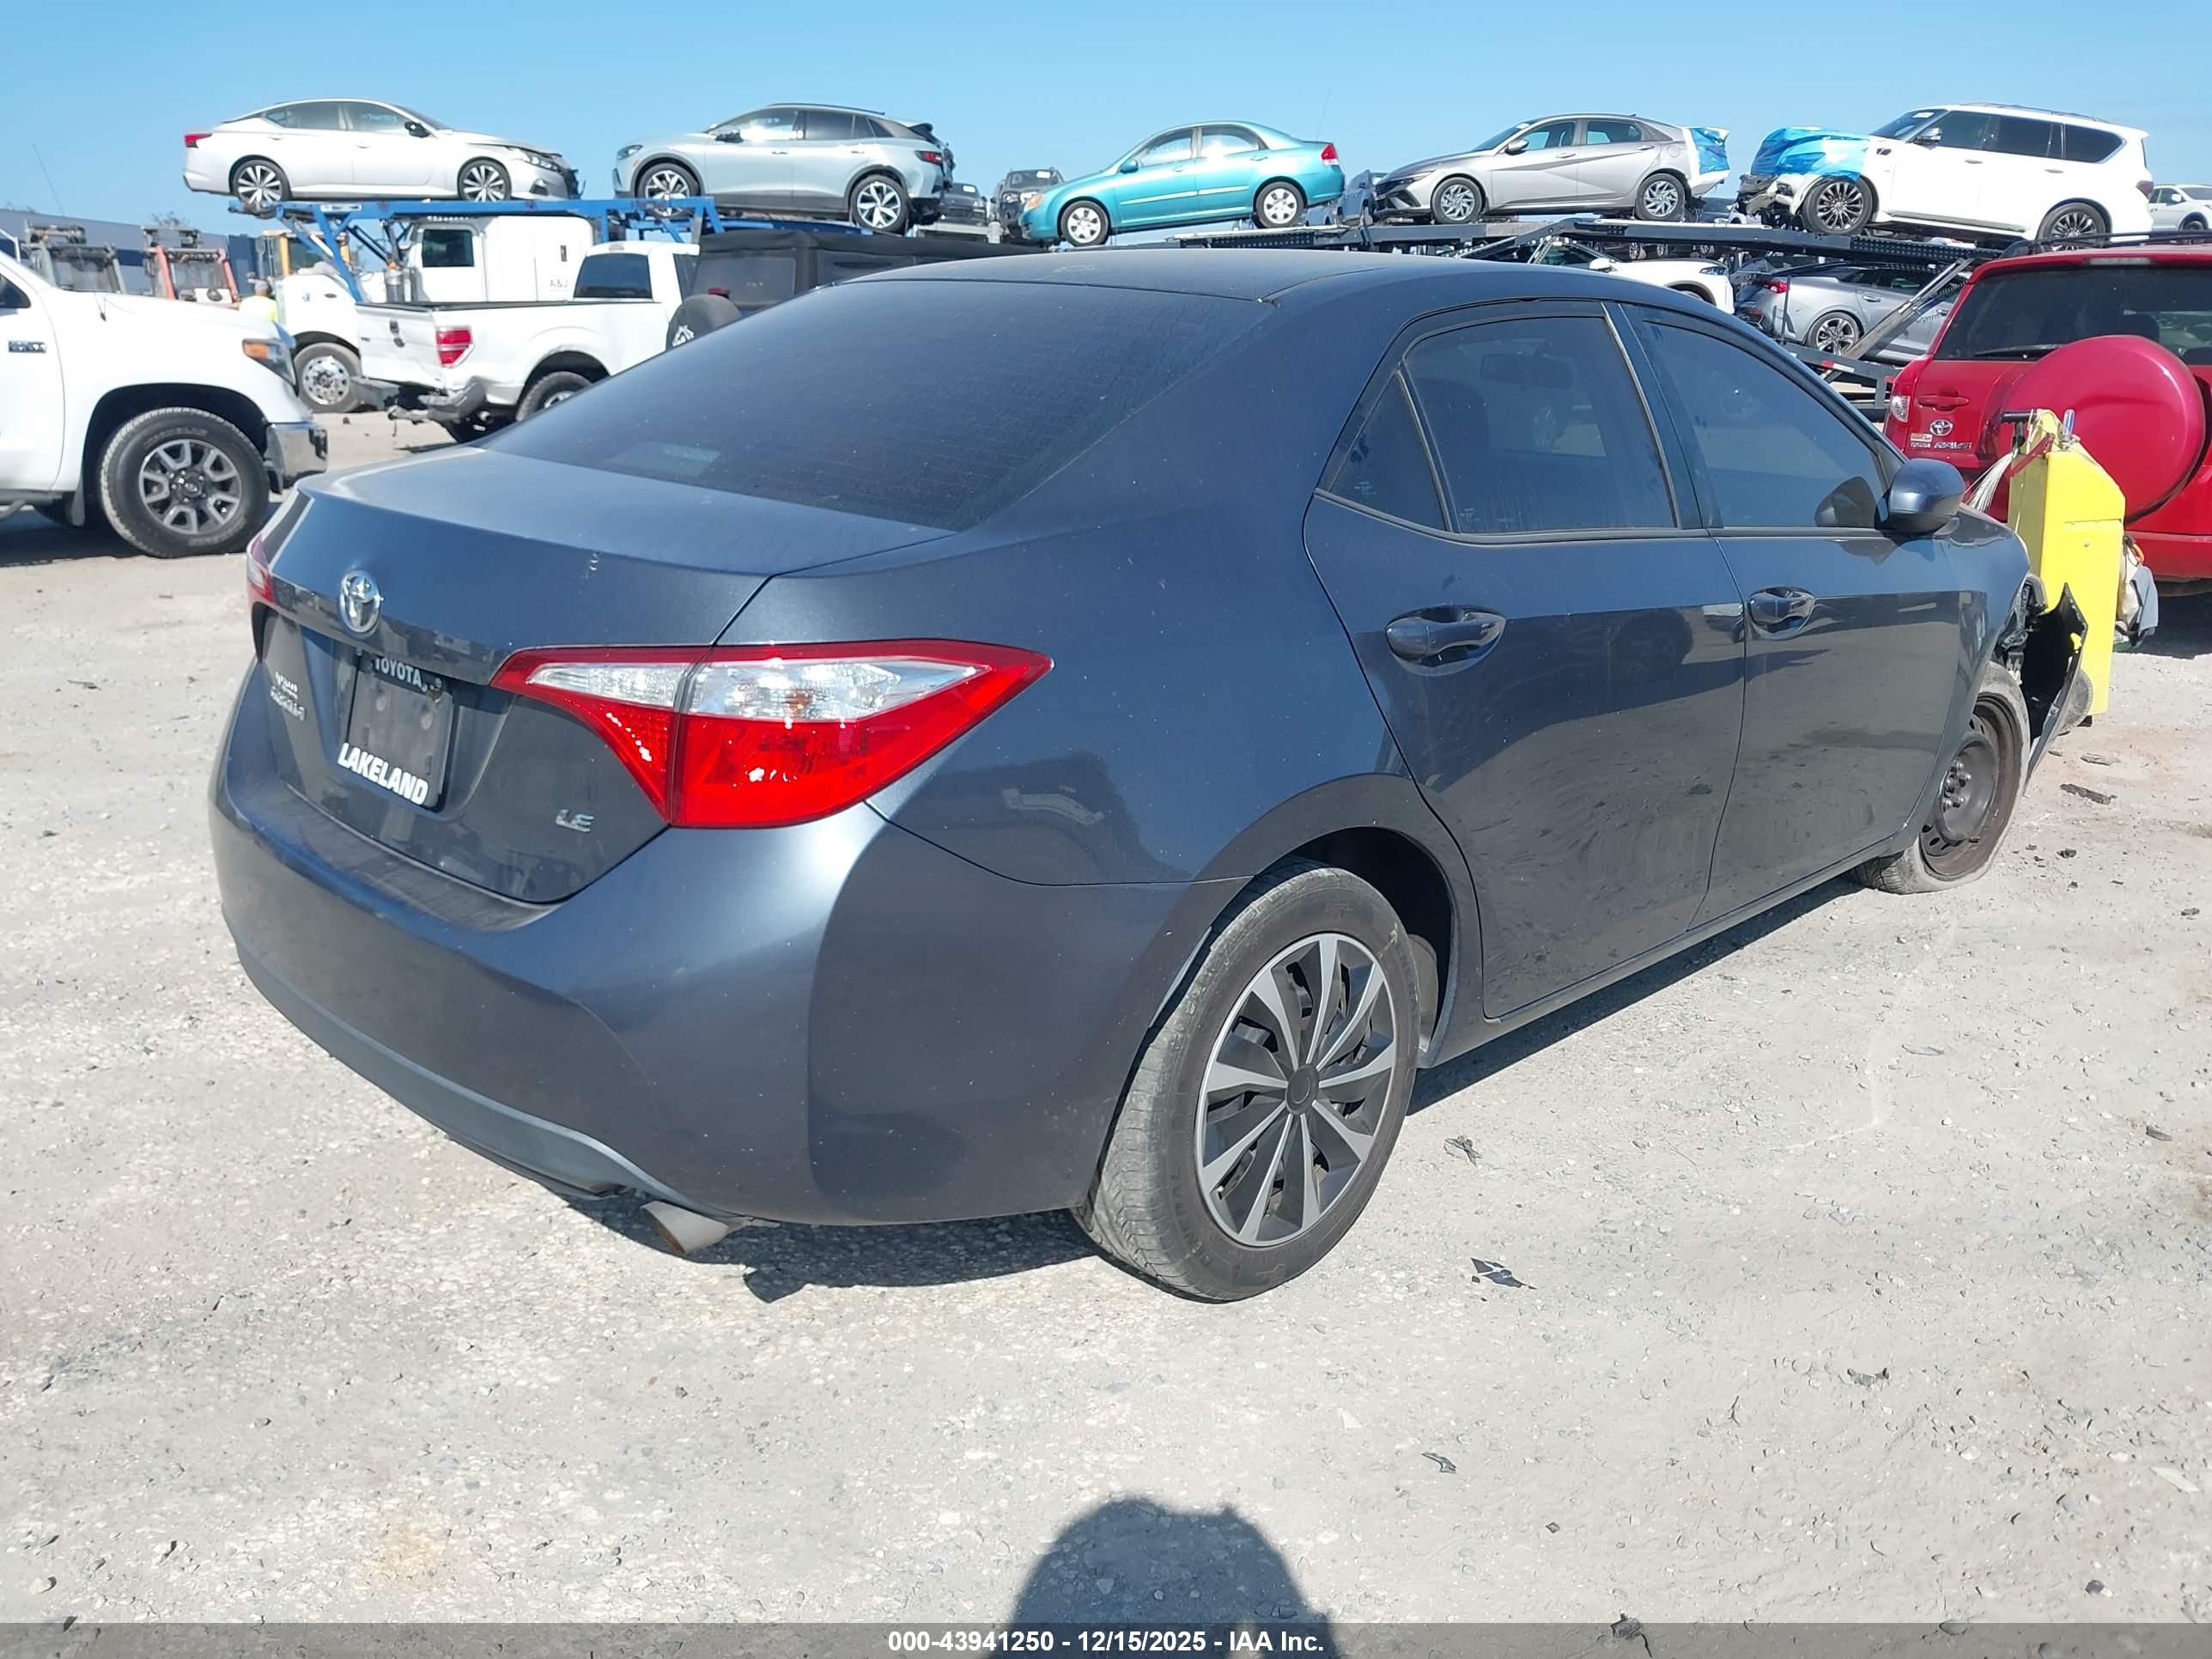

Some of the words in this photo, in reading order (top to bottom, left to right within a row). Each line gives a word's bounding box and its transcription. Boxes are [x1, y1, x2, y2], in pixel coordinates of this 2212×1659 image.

[375, 658, 422, 687] TOYOTA
[337, 742, 428, 805] LAKELAND
[555, 809, 594, 832] LE
